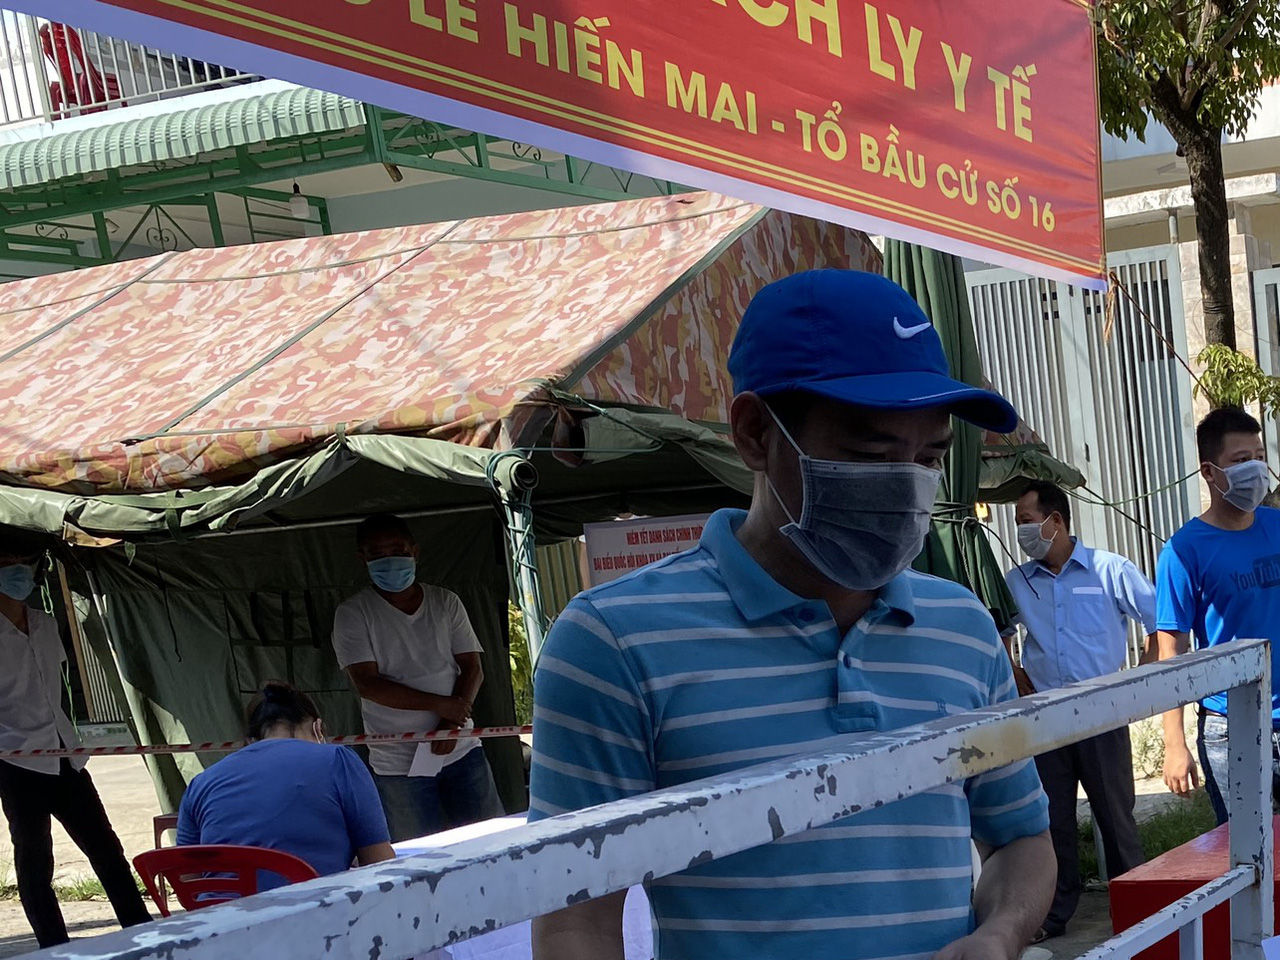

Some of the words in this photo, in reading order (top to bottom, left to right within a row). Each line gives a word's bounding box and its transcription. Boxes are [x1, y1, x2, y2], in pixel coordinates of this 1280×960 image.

[504, 3, 645, 98] HIẾN
[665, 61, 758, 134] MAI
[795, 101, 848, 161] TỔ
[860, 124, 926, 188] BẦU
[936, 159, 978, 206] CỬ
[986, 176, 1021, 220] SỐ
[1028, 195, 1056, 232] 16
[864, 2, 923, 90] LY
[940, 41, 973, 113] Y
[987, 63, 1037, 143] TẾ
